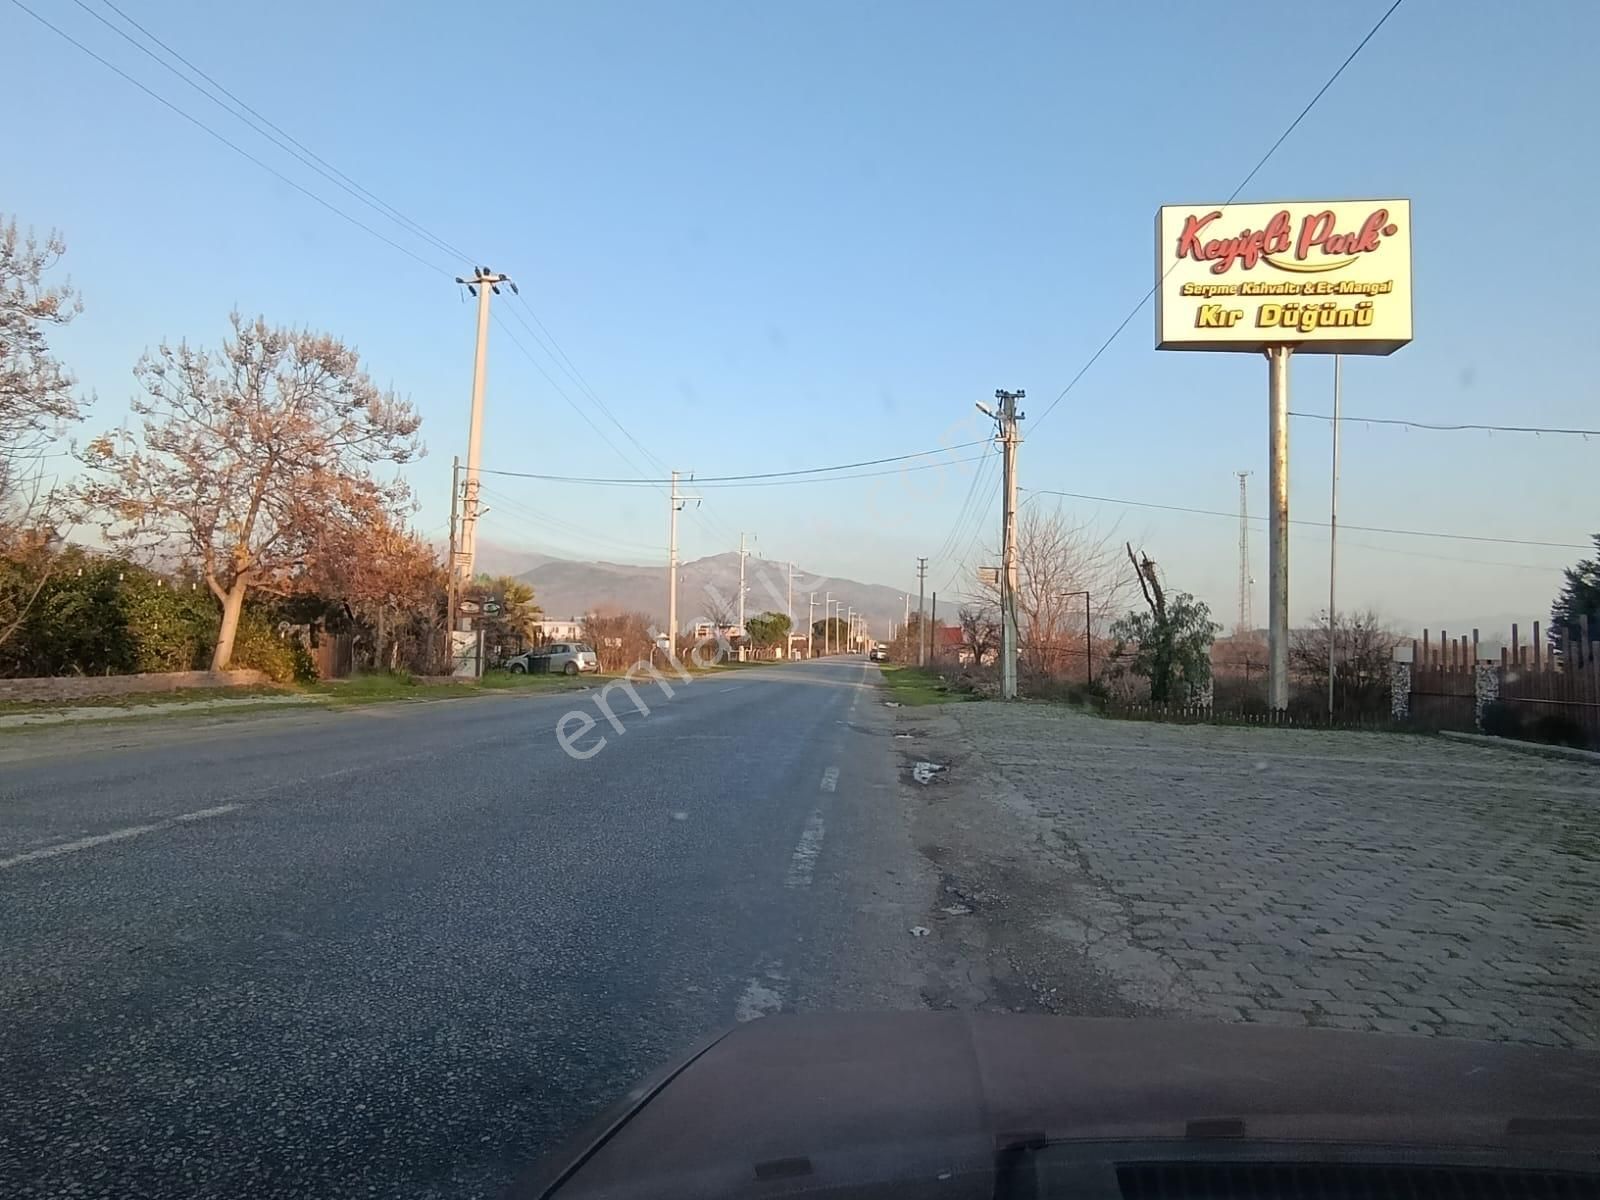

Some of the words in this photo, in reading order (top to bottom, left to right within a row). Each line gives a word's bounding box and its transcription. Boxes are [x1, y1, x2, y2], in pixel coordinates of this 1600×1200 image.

[1177, 210, 1291, 274] Keyifli
[1296, 208, 1388, 260] Park
[1181, 282, 1237, 298] Serpme
[1195, 304, 1244, 328] Kır
[1255, 301, 1374, 333] Düğünü
